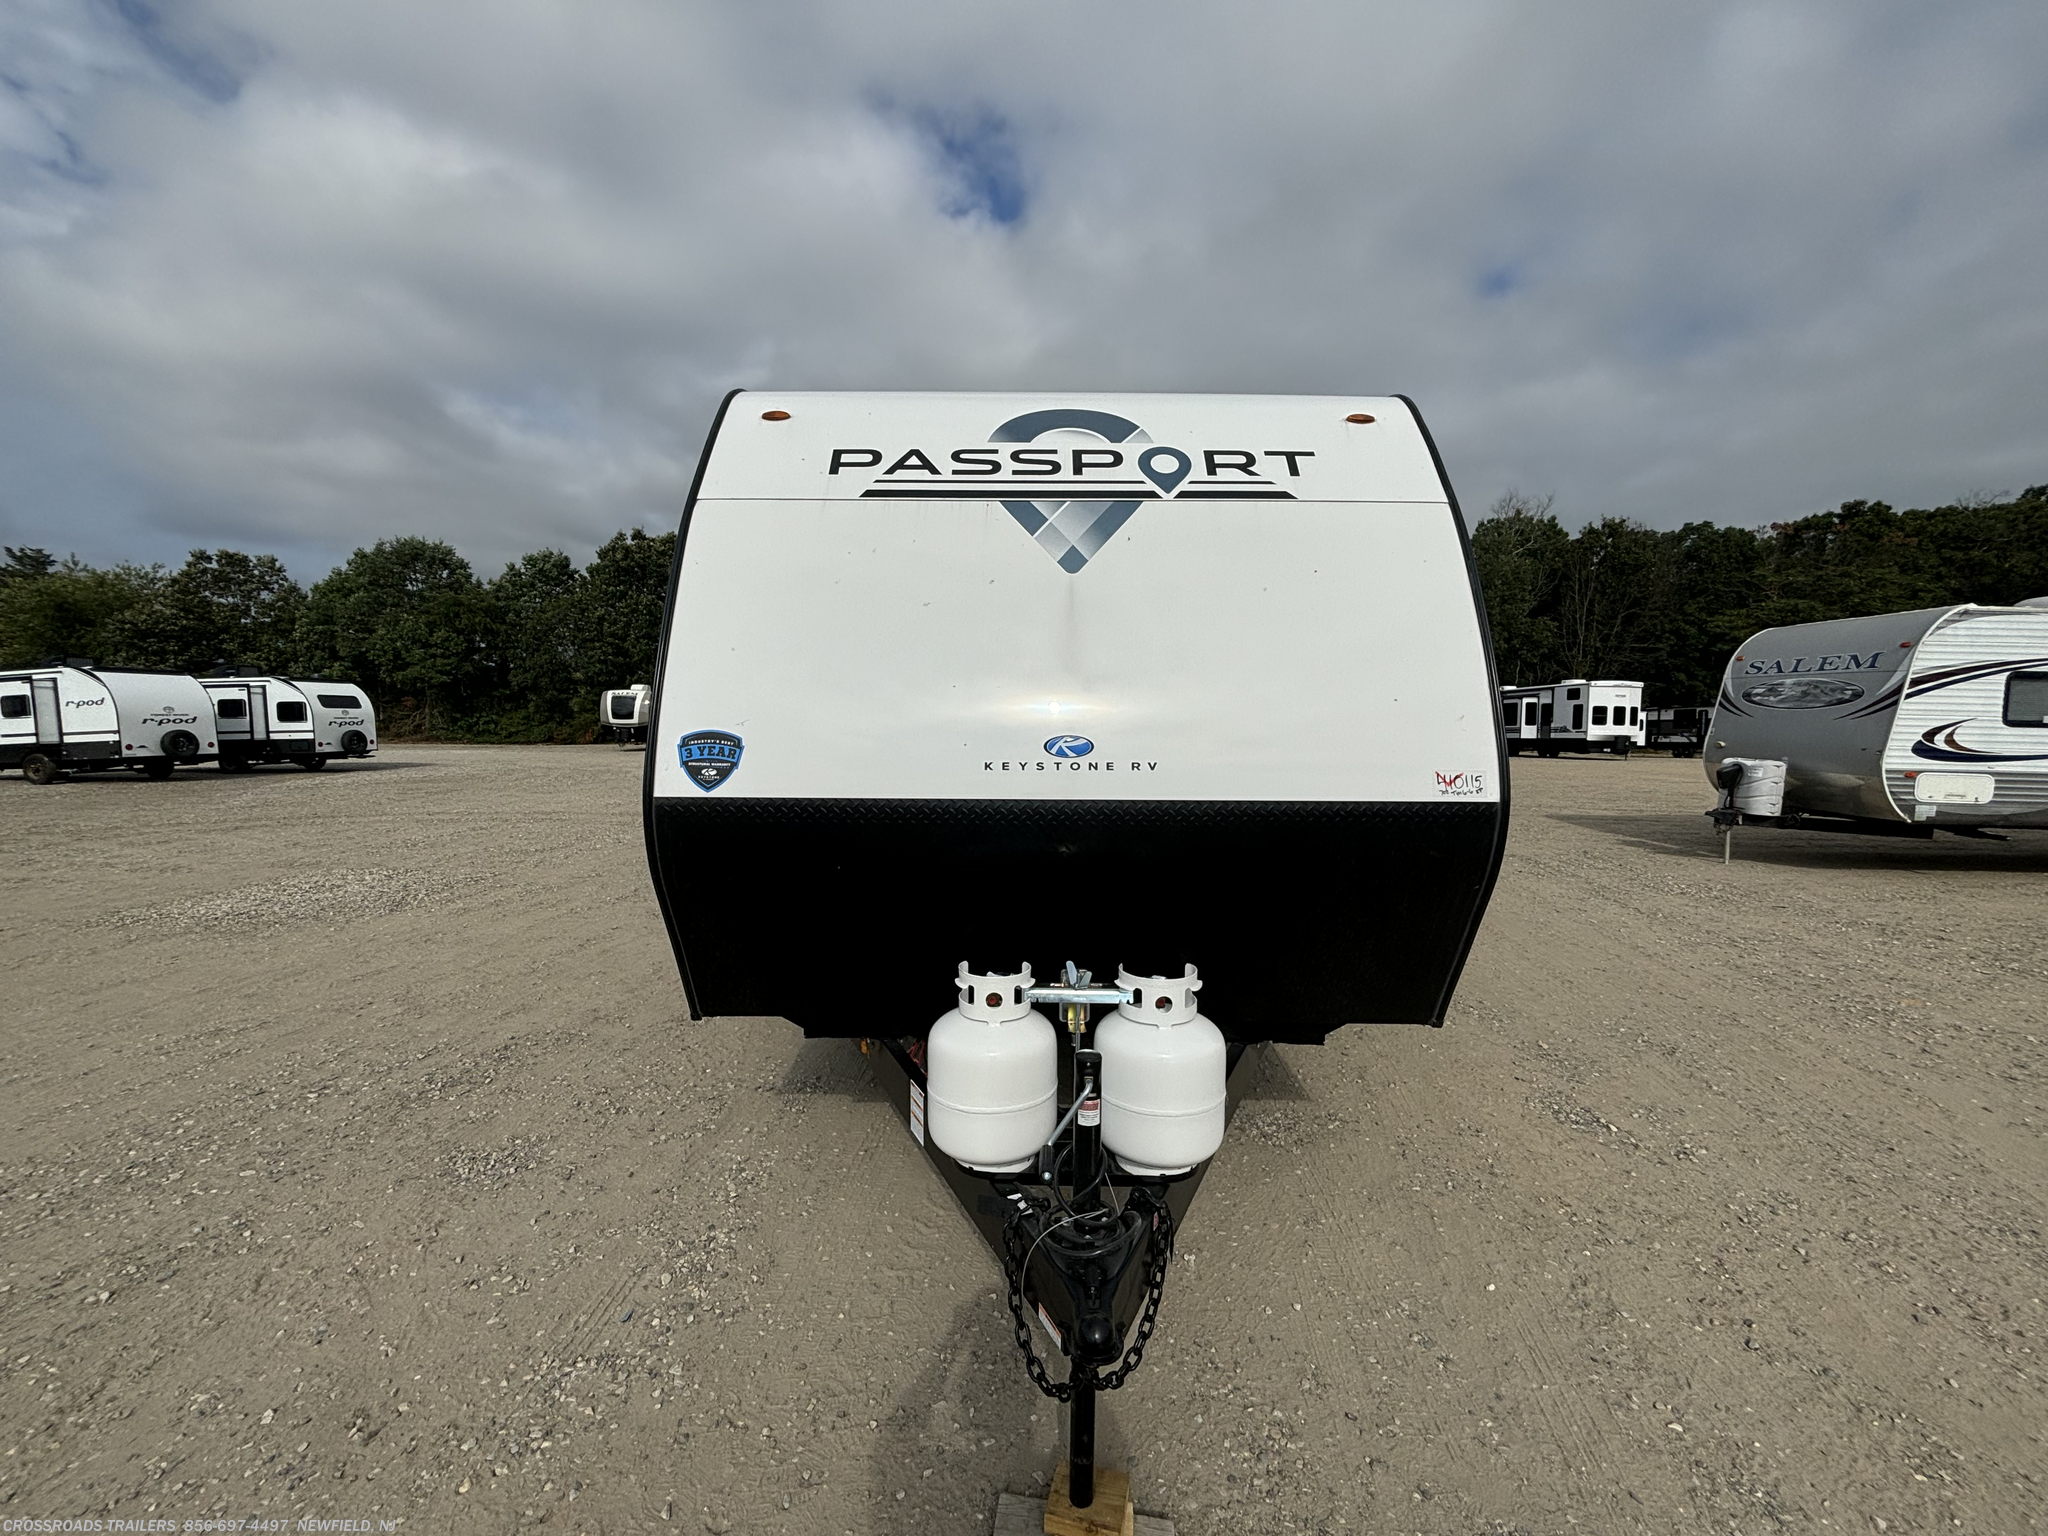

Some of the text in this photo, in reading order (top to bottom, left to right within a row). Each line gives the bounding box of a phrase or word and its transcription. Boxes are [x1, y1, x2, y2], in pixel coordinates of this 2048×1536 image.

[828, 446, 1316, 495] PASSPORT
[1744, 651, 1886, 675] SALEM
[141, 715, 198, 727] r-pod
[684, 745, 737, 760] 3 YEAR
[984, 761, 1158, 771] KEYSTONE RV
